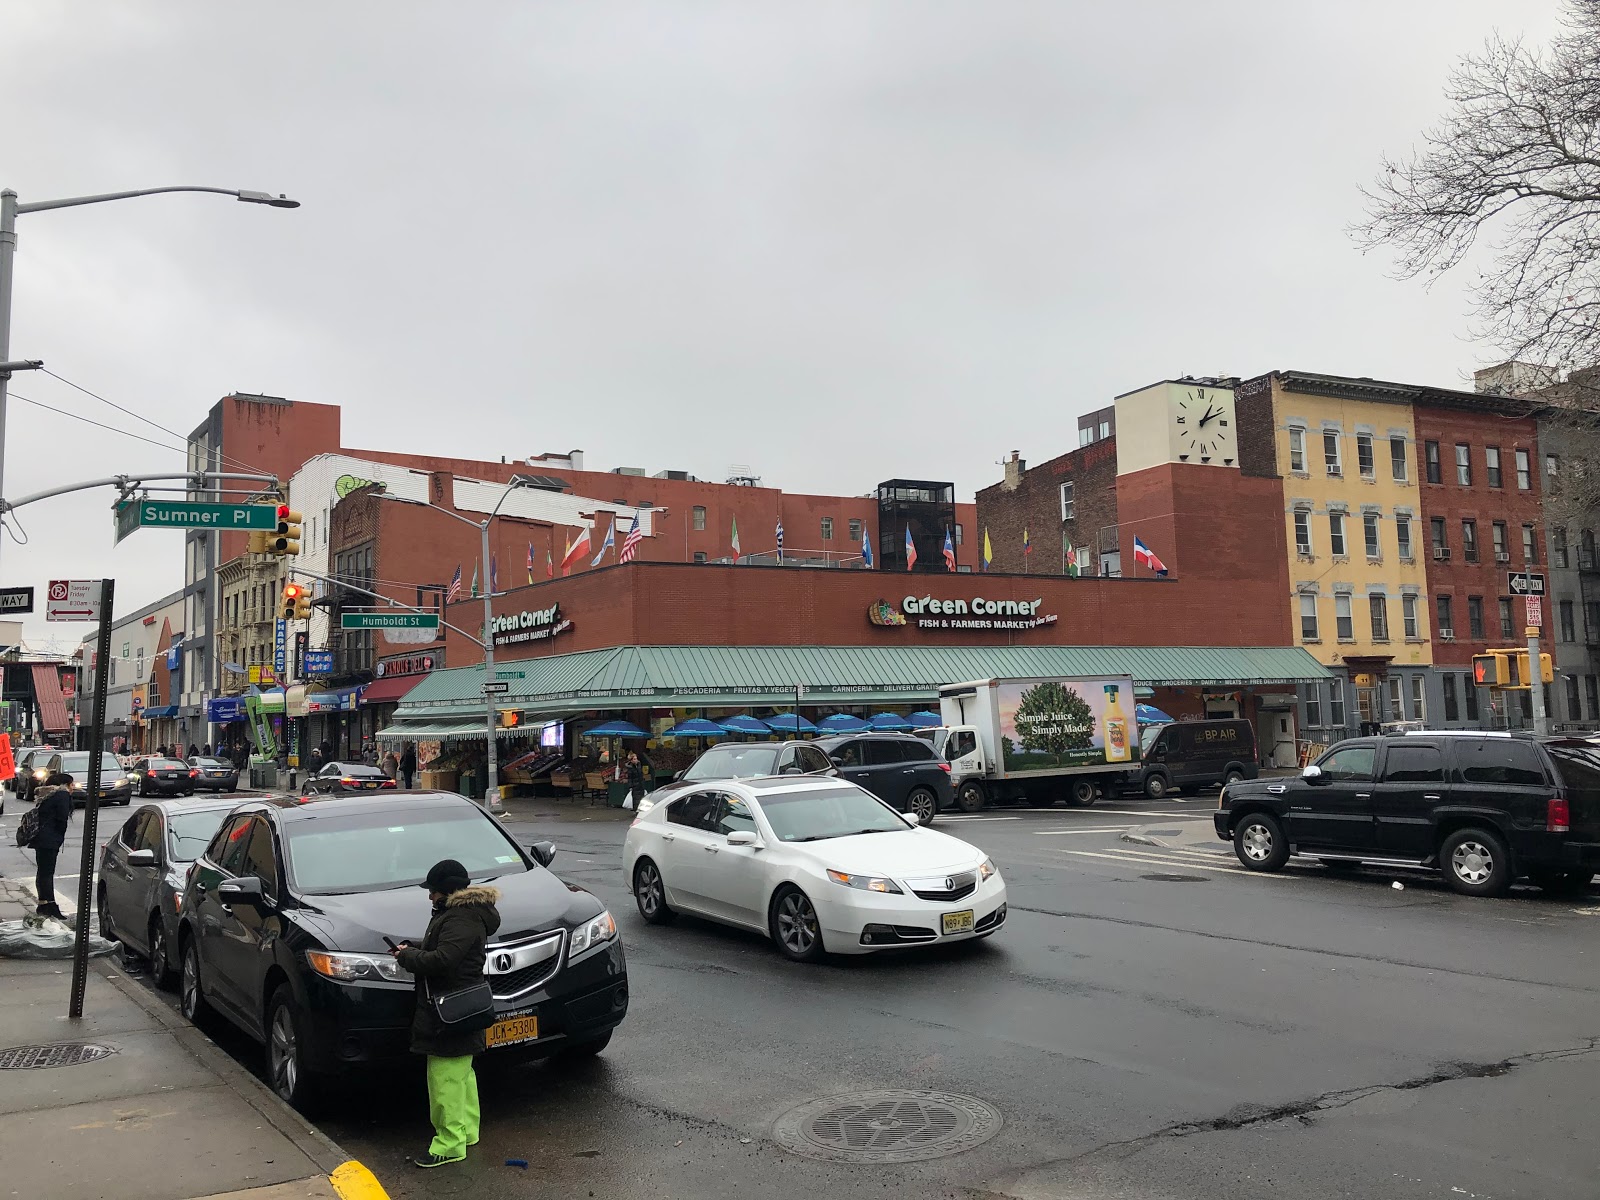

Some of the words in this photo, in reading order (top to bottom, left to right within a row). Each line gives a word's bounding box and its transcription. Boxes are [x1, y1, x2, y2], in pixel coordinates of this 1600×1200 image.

[144, 506, 220, 523] Sumner
[233, 509, 251, 524] Pl
[70, 585, 91, 593] Tuesday
[1514, 579, 1526, 589] ONE
[1, 595, 24, 607] WAY
[69, 591, 86, 599] Friday
[902, 593, 968, 615] Green
[971, 596, 1042, 616] Corner
[362, 616, 408, 626] Humboldt
[410, 617, 420, 626] St
[491, 614, 519, 634] Green
[520, 602, 557, 629] Corner
[918, 619, 940, 628] FISH
[941, 620, 949, 628] &
[951, 620, 992, 629] FARMERS
[994, 620, 1030, 629] MARKET
[495, 636, 506, 645] FISH
[510, 632, 530, 643] FARMERS
[530, 629, 550, 640] MARKET
[276, 619, 285, 672] PHARMACY
[385, 659, 409, 675] FAMOUS
[411, 657, 424, 672] DELI
[578, 690, 590, 698] Free
[590, 690, 612, 699] Delivery
[673, 687, 721, 695] PESCADERIA
[733, 686, 762, 694] FRUTAS
[764, 686, 768, 694] Y
[770, 686, 810, 694] VEGETAES
[883, 684, 916, 692] DELIVERY
[1018, 713, 1049, 724] Simple
[1050, 712, 1076, 722] Juice.
[1031, 725, 1062, 736] Simply
[1064, 723, 1090, 733] Made.
[1204, 729, 1218, 740] BP
[1220, 728, 1237, 739] AIR
